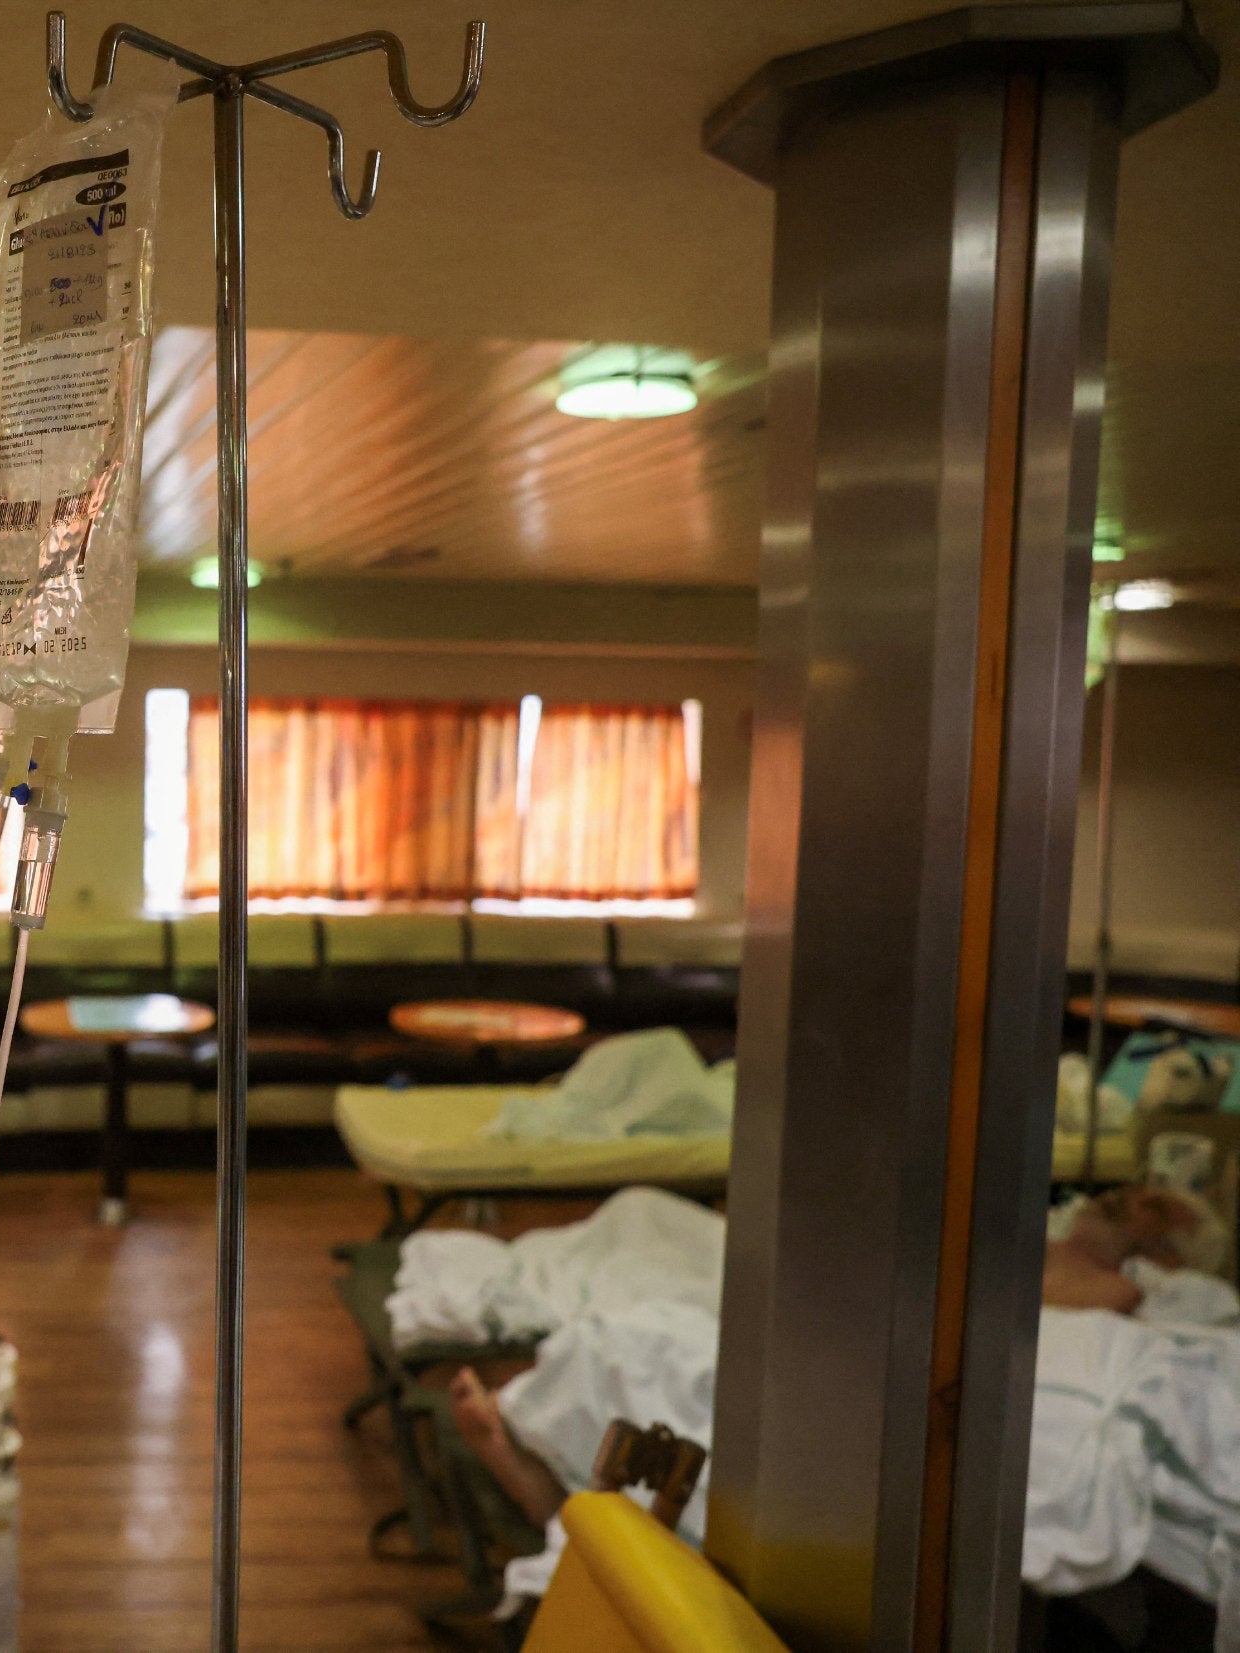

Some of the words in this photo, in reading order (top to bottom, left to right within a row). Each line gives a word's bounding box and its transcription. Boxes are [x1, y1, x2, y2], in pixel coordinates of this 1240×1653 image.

[86, 189, 103, 202] 500
[44, 639, 55, 653] 02
[61, 636, 87, 652] 2025
